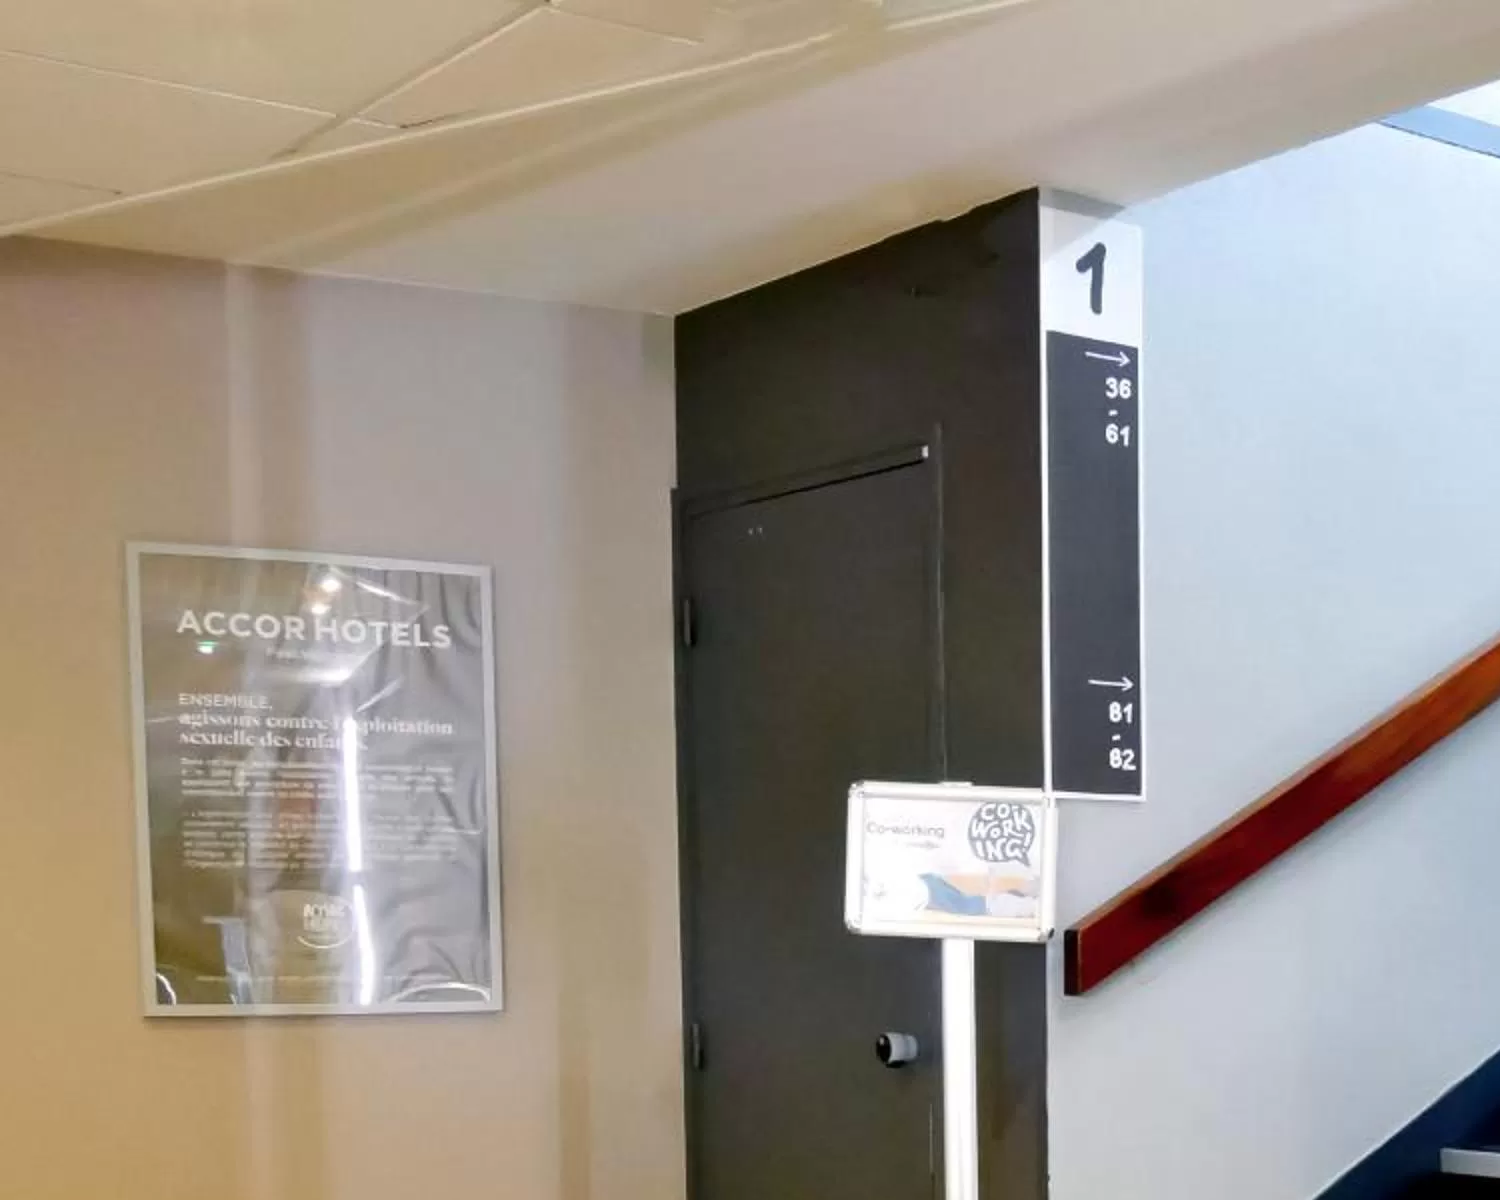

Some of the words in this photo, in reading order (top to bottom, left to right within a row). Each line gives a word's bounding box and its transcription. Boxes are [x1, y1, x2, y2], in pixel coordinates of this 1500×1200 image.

[1076, 241, 1107, 315] 1
[1105, 376, 1131, 399] 36
[1105, 423, 1130, 447] 61
[176, 609, 305, 641] ACCOR
[314, 616, 452, 649] HOTELS
[1109, 702, 1133, 723] 81
[1109, 748, 1136, 770] 82
